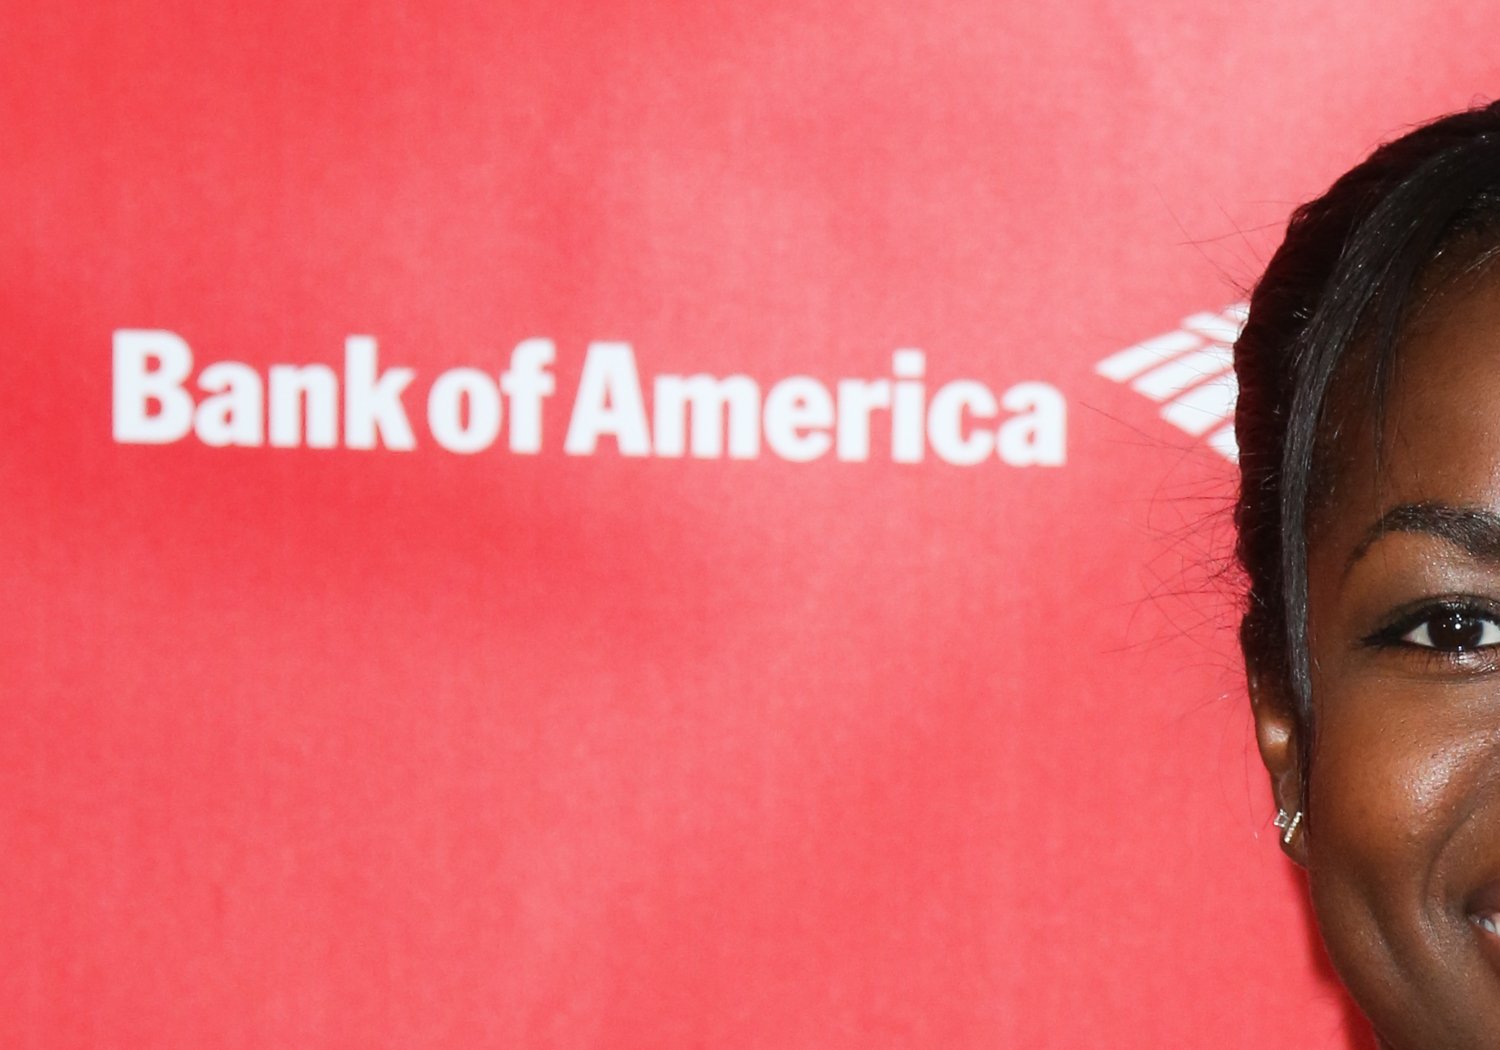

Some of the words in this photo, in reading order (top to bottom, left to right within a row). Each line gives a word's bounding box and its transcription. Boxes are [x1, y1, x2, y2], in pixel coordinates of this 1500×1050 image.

[112, 330, 415, 450] Bank
[427, 339, 556, 454] of
[564, 341, 1067, 468] America
